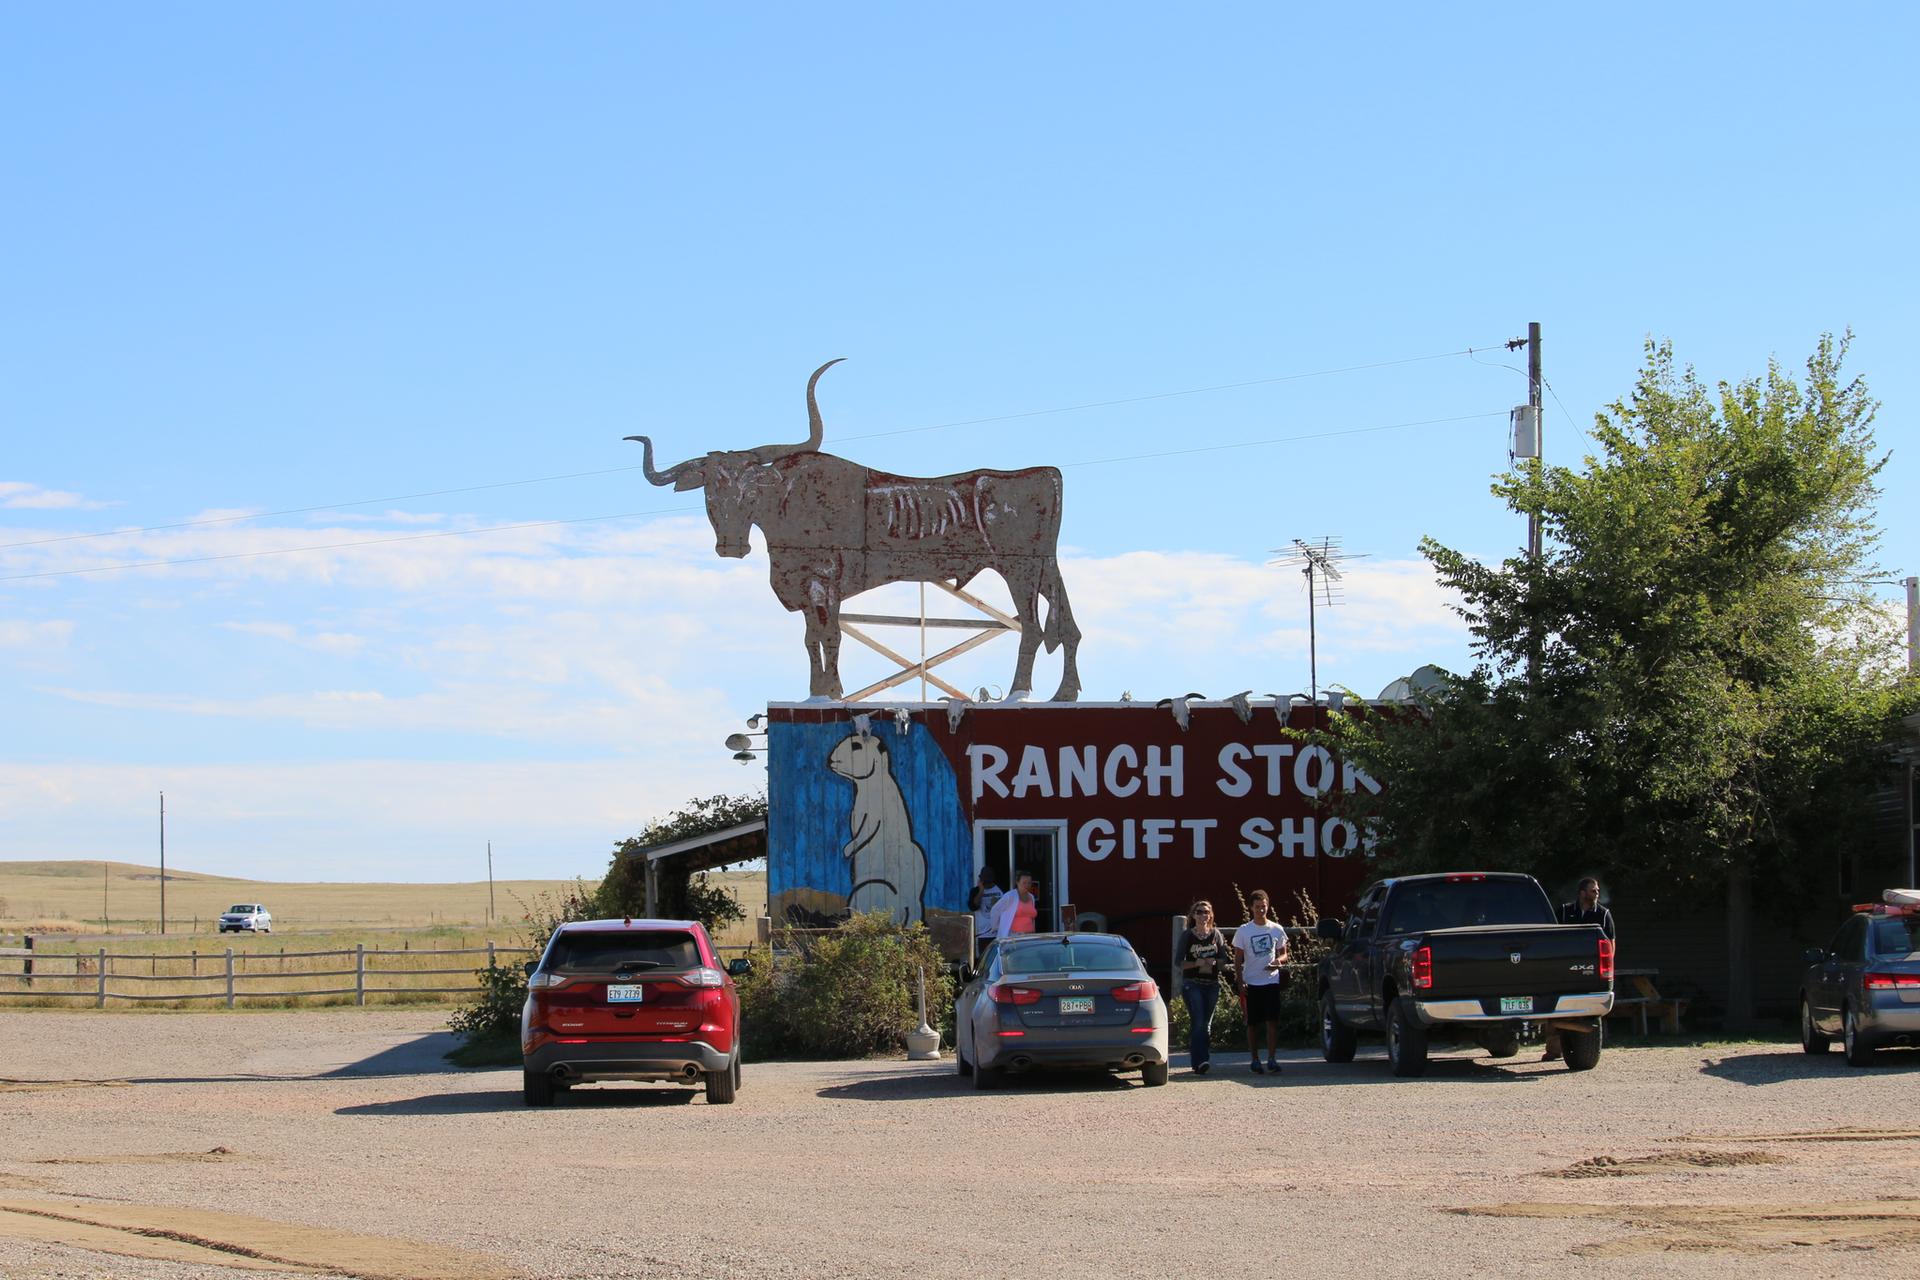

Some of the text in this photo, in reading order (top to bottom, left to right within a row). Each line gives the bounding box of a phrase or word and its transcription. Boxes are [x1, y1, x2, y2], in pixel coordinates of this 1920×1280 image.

[966, 742, 1383, 801] RANCH STOR
[1076, 818, 1217, 861] GIFT
